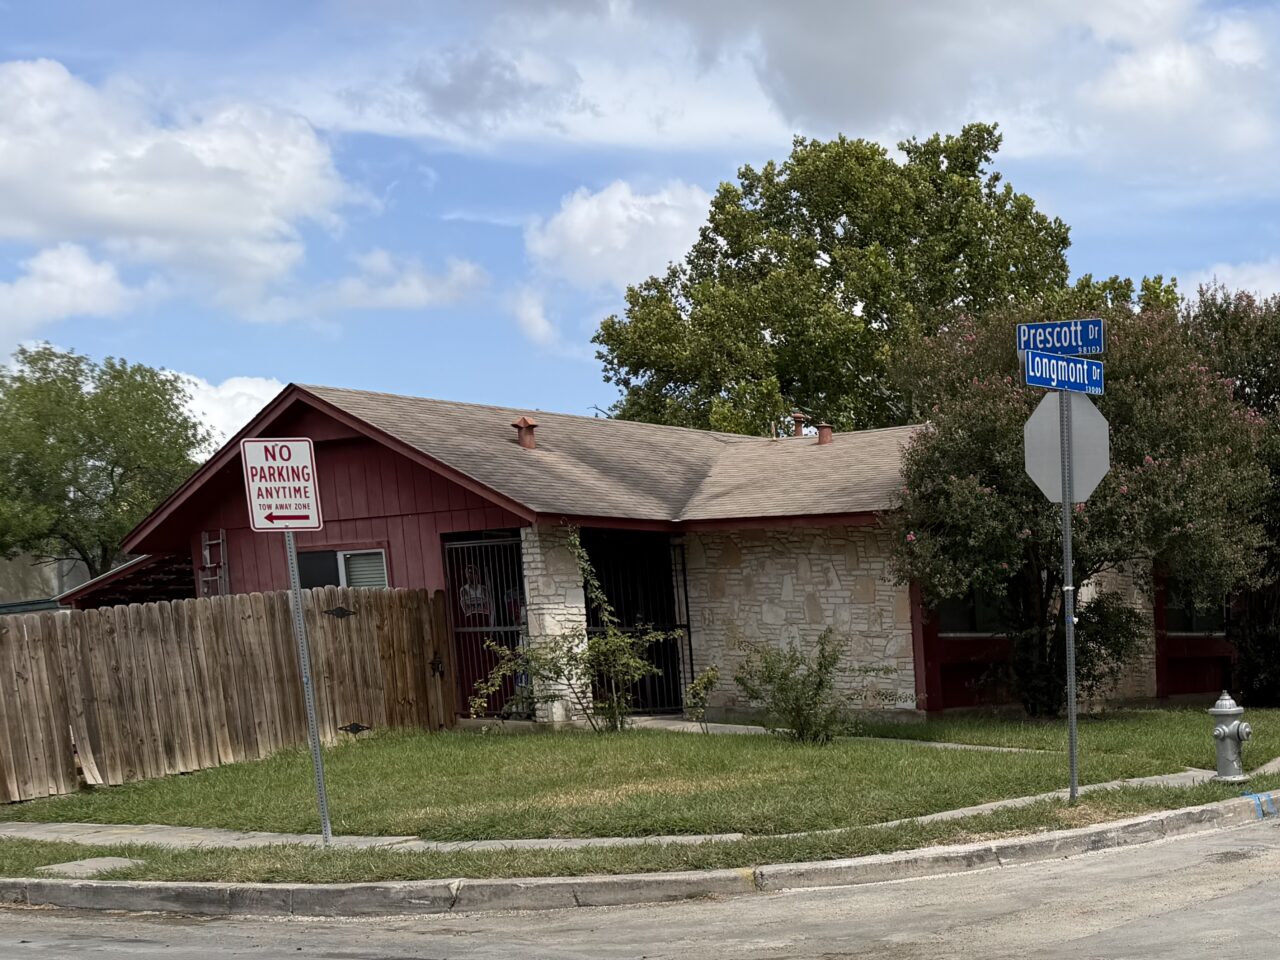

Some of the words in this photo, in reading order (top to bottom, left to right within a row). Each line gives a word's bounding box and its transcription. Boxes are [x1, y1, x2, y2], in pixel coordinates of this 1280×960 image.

[1020, 321, 1082, 349] Prescott
[1088, 324, 1099, 339] Dr
[1028, 351, 1089, 386] Longmont
[1092, 365, 1101, 380] Dr
[264, 444, 291, 461] NO
[250, 465, 311, 483] PARKING
[257, 486, 310, 499] ANYTIME
[258, 503, 272, 511] TOW
[294, 502, 311, 510] ZONE
